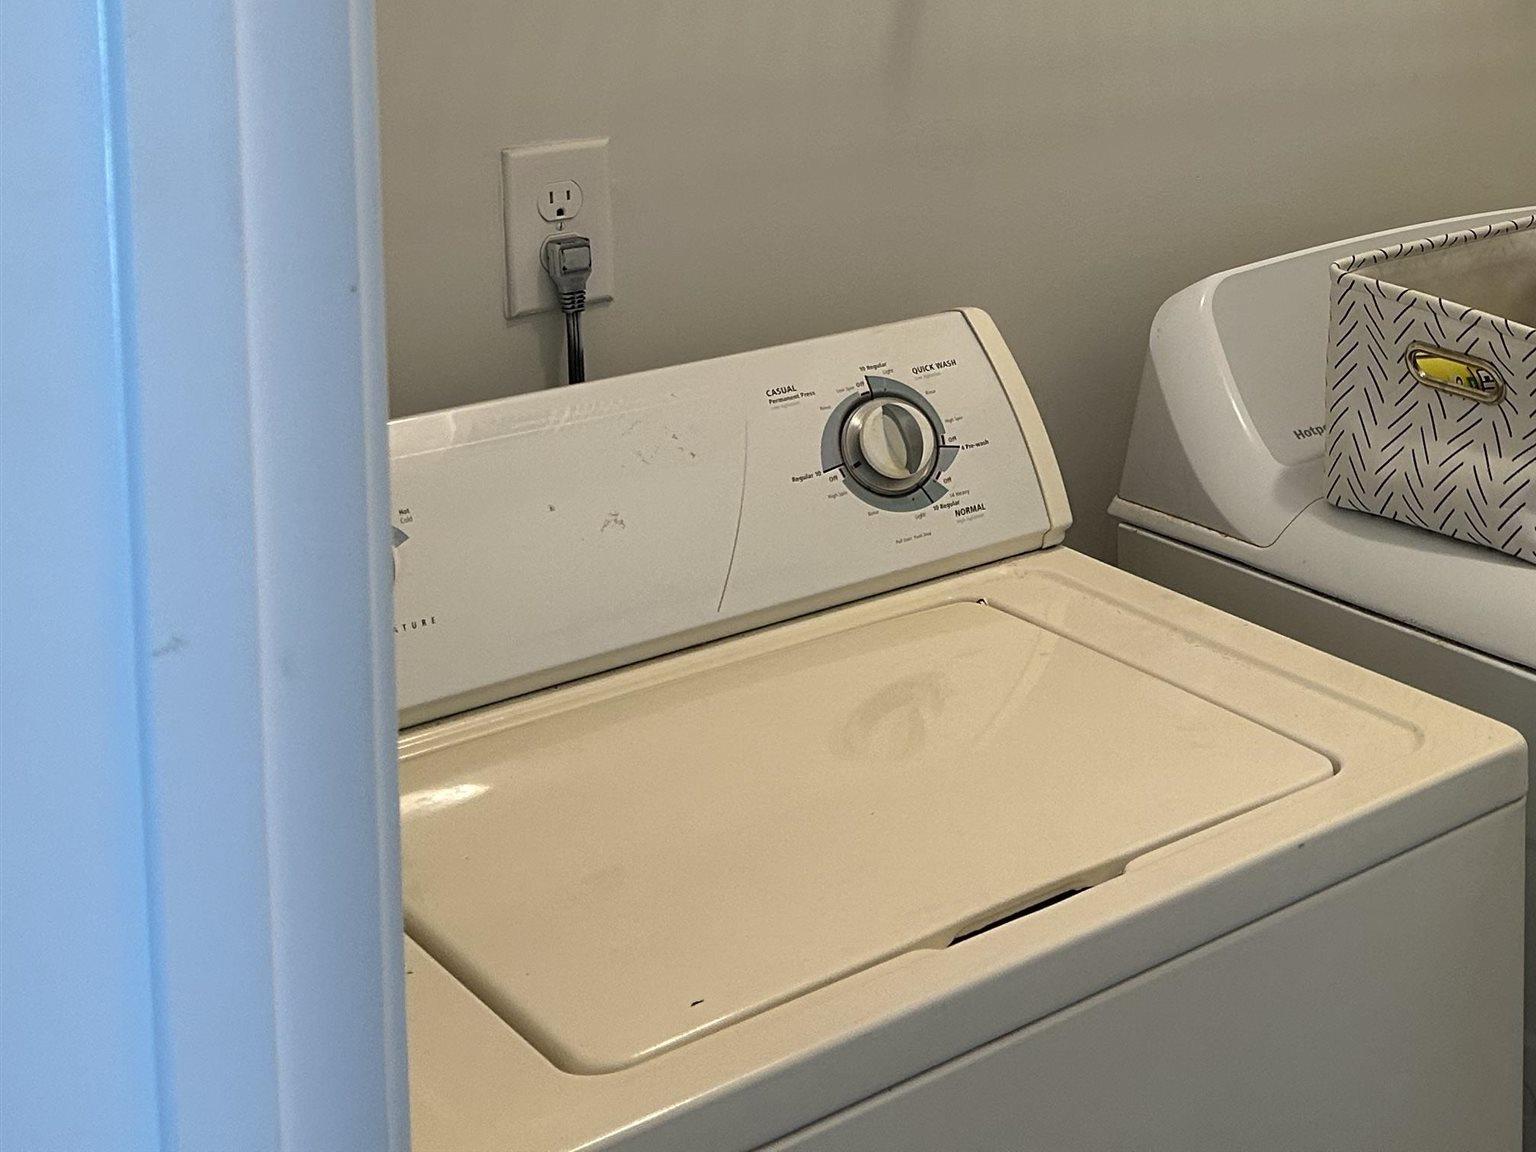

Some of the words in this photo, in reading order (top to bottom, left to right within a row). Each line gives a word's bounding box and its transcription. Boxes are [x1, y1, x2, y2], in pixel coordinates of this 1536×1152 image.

[866, 362, 887, 370] Regular
[912, 364, 935, 374] QUICK
[935, 359, 957, 369] WASH
[765, 385, 797, 397] CASUAL
[768, 394, 800, 404] Permanent
[792, 473, 814, 482] Regular
[940, 500, 960, 509] Regular
[954, 503, 986, 517] NORMAL
[400, 516, 413, 524] Cold
